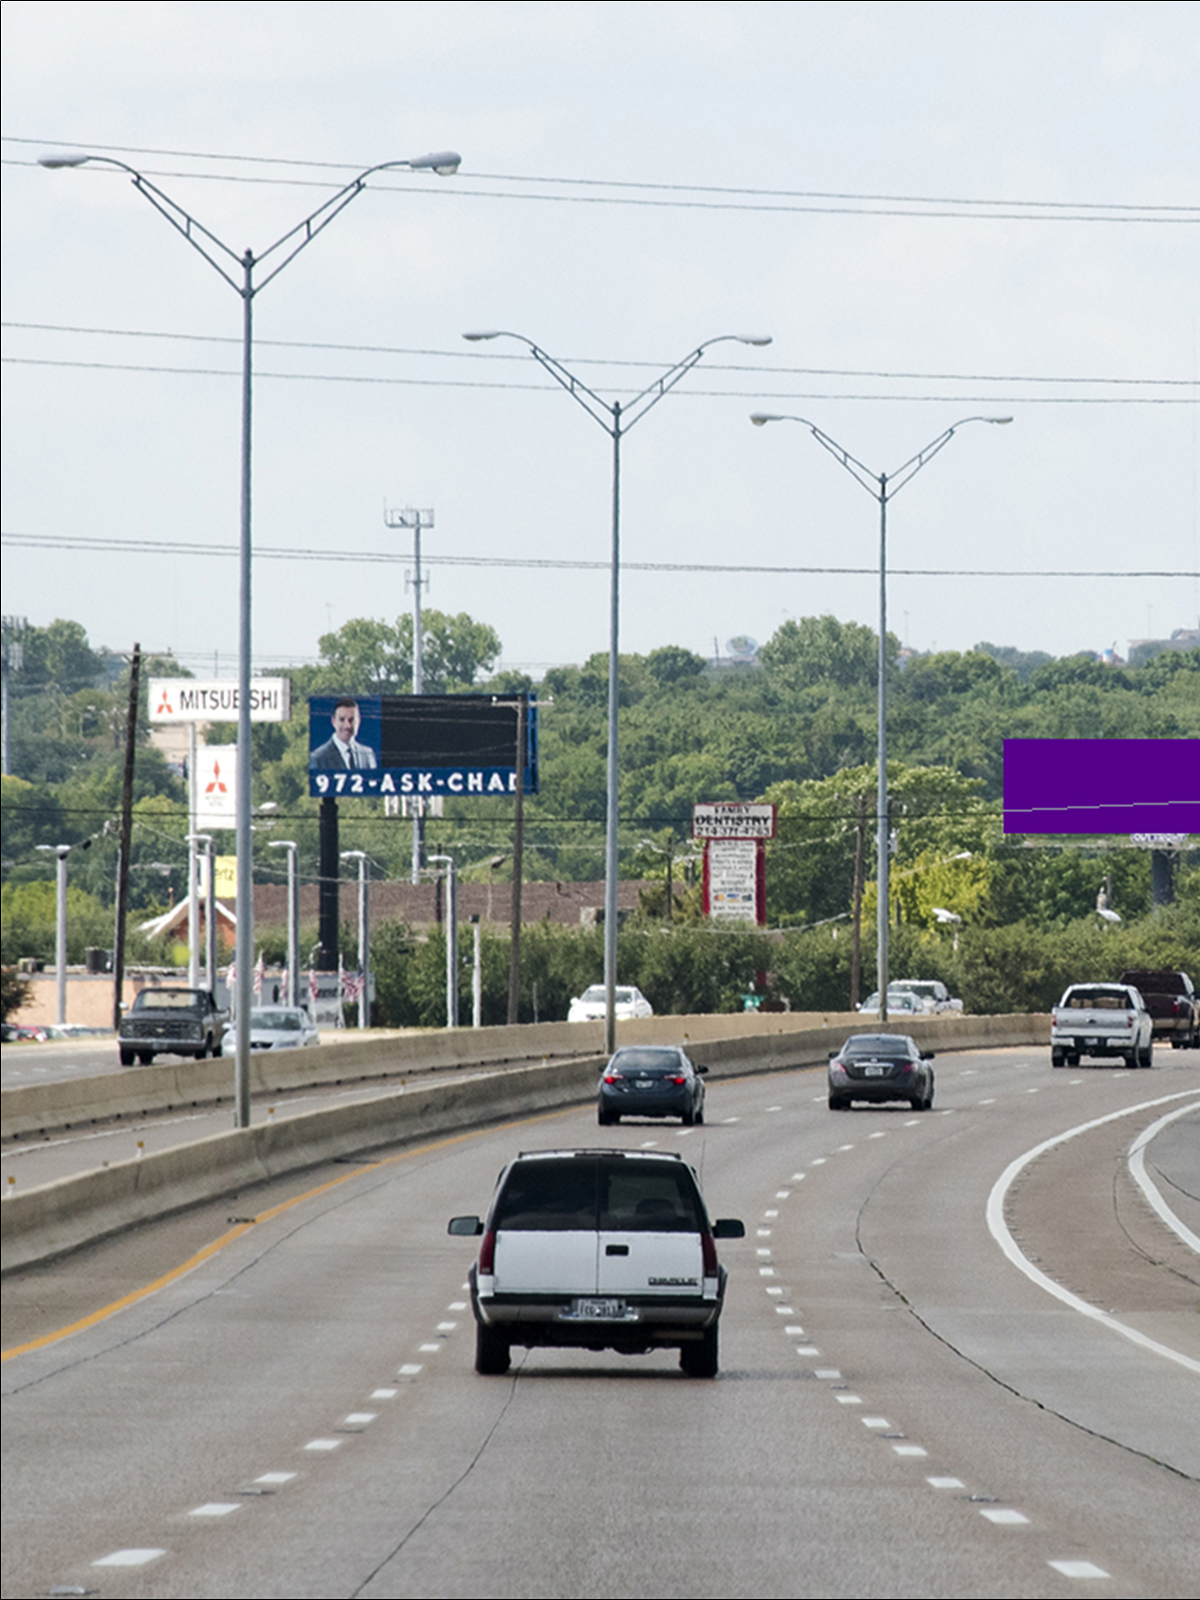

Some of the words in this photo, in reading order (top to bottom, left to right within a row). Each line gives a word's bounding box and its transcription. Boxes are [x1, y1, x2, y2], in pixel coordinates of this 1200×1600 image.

[180, 689, 278, 710] MITSUBSHI
[695, 815, 770, 826] DENTISTRY
[214, 868, 235, 881] ertz
